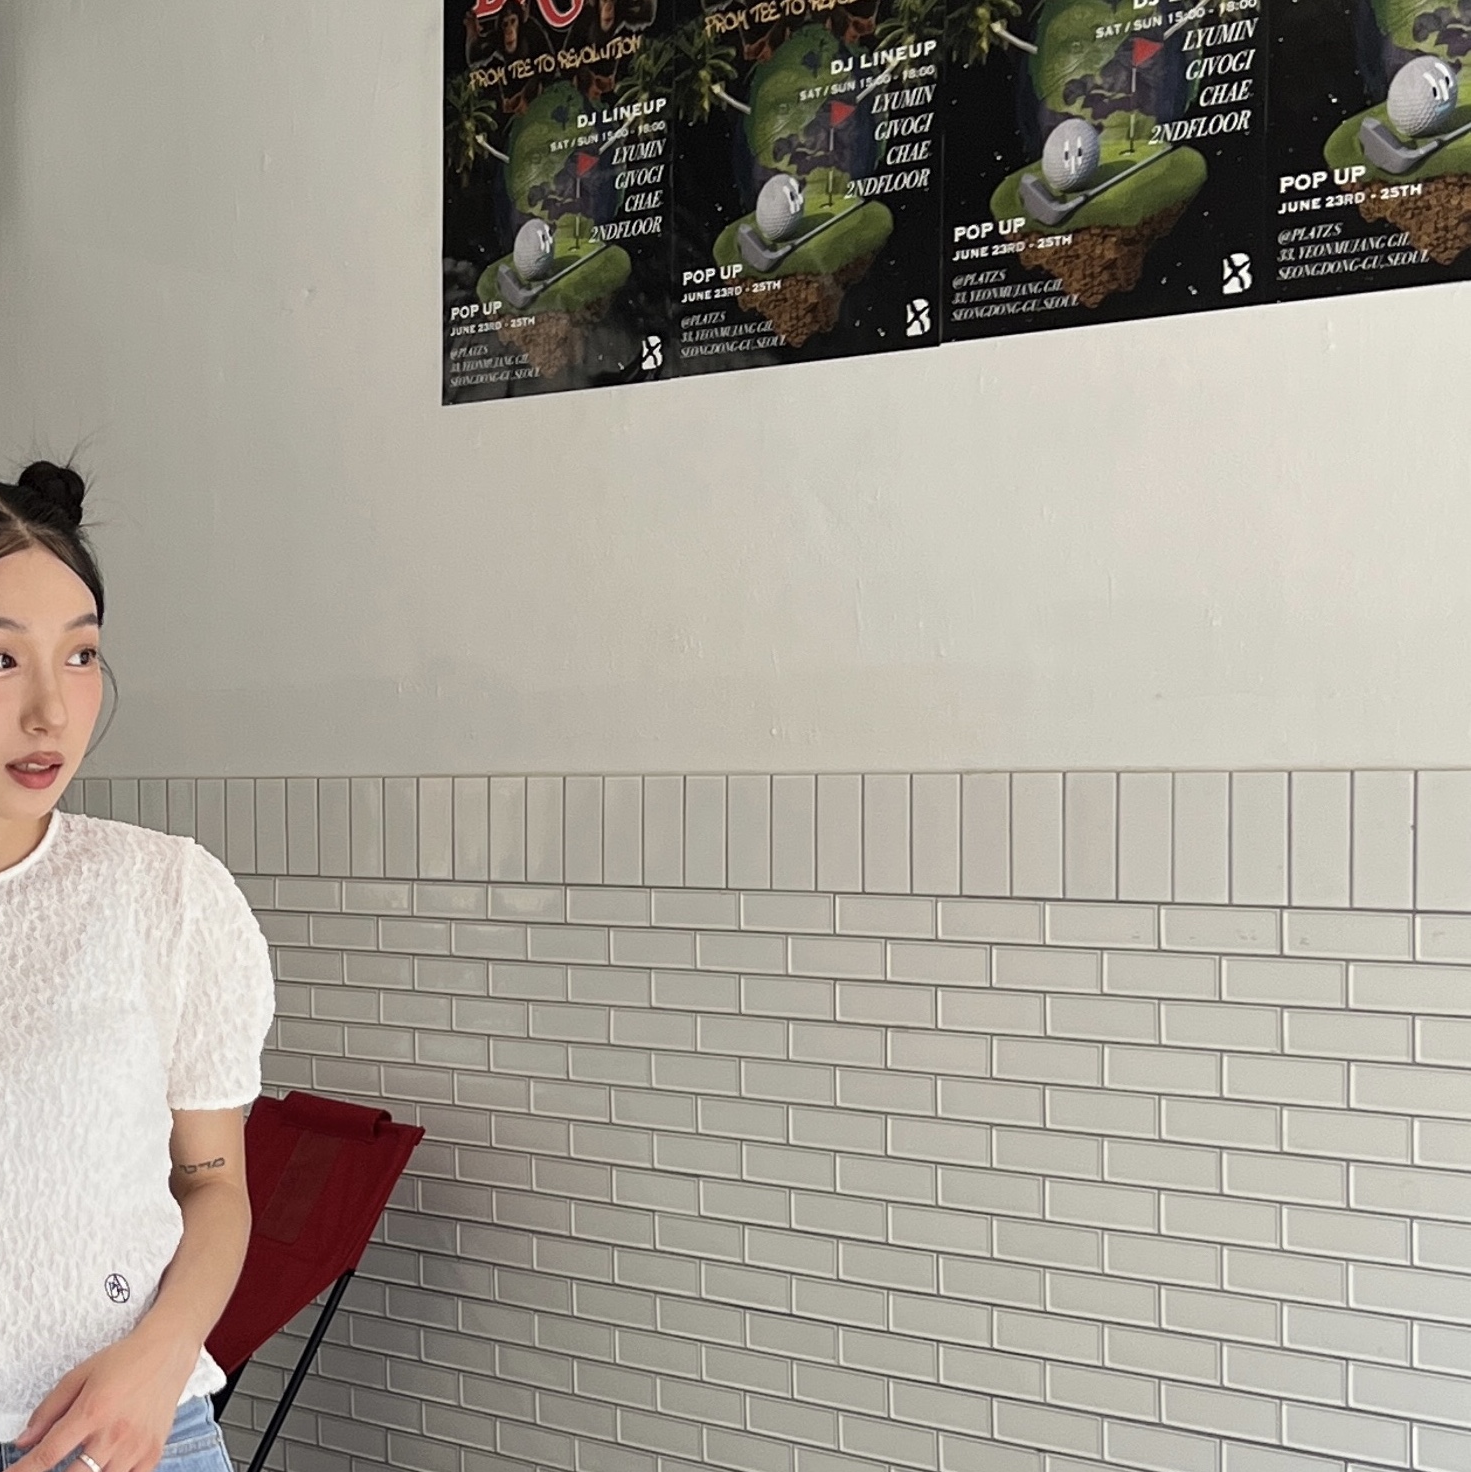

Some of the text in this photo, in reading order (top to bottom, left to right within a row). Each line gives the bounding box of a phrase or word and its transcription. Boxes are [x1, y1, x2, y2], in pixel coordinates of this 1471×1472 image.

[750, 1, 781, 23] TEE
[780, 0, 805, 16] TO
[1095, 23, 1122, 39] SAT
[1133, 15, 1163, 31] SUN
[1182, 17, 1259, 51] LYUMIN
[508, 58, 534, 79] TEE
[534, 53, 555, 72] TO
[558, 34, 642, 69] REVOLUTION
[830, 40, 937, 75] DJ LINEUP
[1185, 49, 1256, 80] GIVOGI
[799, 87, 822, 101] SAT
[830, 80, 856, 95] SUN
[871, 84, 937, 114] LYUMIN
[1199, 79, 1253, 107] CHAE
[577, 98, 667, 128] DJ LINEUP
[874, 112, 935, 141] GIVOGI
[1148, 109, 1252, 145] 2NDFLOOR
[550, 139, 569, 152] SAT
[577, 134, 598, 147] SUN
[611, 138, 667, 165] LYUMIN
[886, 140, 931, 165] CHAE
[614, 164, 665, 190] GIVOGI
[843, 168, 931, 199] 2NDFLOOR
[1279, 165, 1366, 193] POP UP
[624, 190, 664, 212] CHAE
[1277, 197, 1322, 214] JUNE
[1325, 192, 1366, 208] 23RD
[1380, 183, 1423, 200] 25TH
[588, 216, 663, 243] 2NDFLOOR
[953, 217, 1026, 243] POP UP
[952, 246, 989, 261] JUNE
[991, 241, 1026, 256] 23RD
[1037, 234, 1073, 249] 25TH
[682, 263, 743, 286] POP UP
[681, 289, 712, 303] JUNE
[713, 286, 742, 299] 23RD
[751, 280, 782, 293] 25TH
[450, 301, 502, 321] POP UP
[450, 324, 477, 337] JUNE
[510, 316, 536, 328] 25TH
